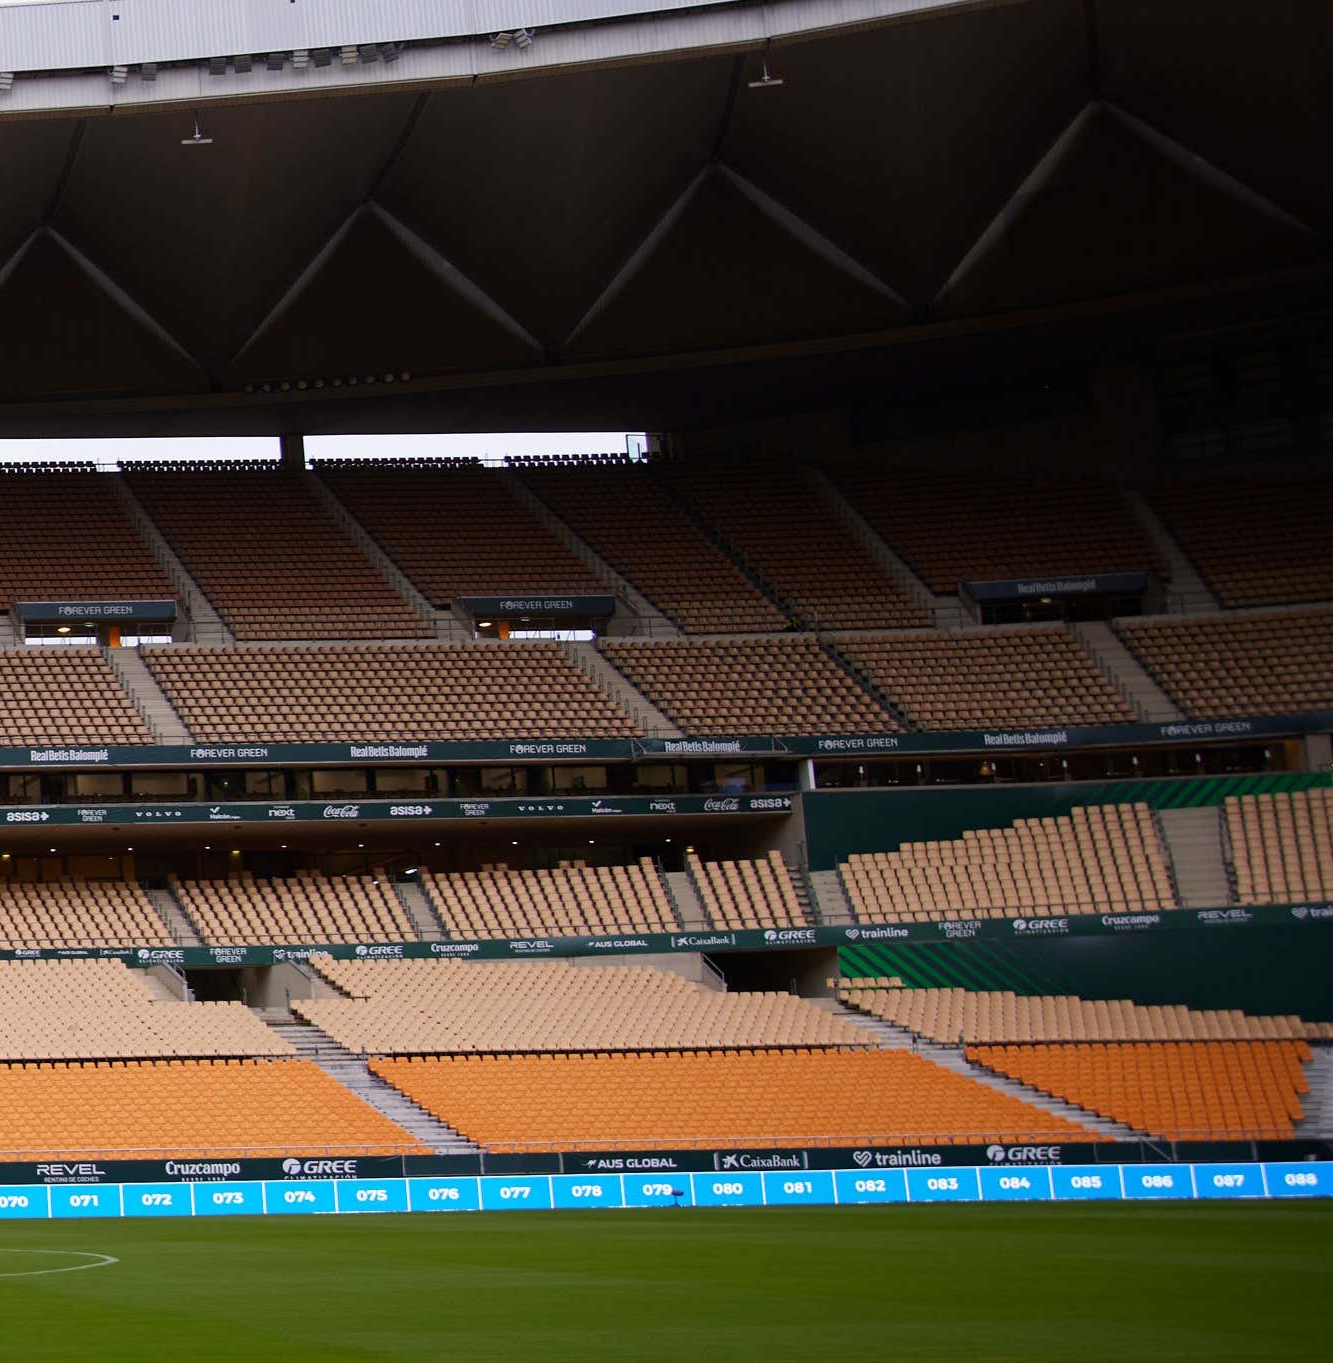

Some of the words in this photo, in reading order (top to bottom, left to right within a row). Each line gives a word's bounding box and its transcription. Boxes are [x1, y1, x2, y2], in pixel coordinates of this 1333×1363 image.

[58, 607, 102, 615] FOREVER
[103, 606, 134, 614] GREEN
[499, 601, 542, 609] FOREVER
[31, 751, 48, 761] Real
[49, 751, 69, 760] Betis
[70, 750, 108, 760] Balompié
[351, 747, 368, 757] Real
[369, 747, 388, 756] Betis
[389, 746, 427, 756] Balompié
[6, 812, 42, 821] asisa
[860, 928, 909, 938] trainline
[209, 948, 247, 956] FOREVER
[368, 946, 404, 954] GREE
[430, 944, 480, 952] Cruzcampo
[874, 1150, 942, 1165] trainline
[1007, 1147, 1061, 1160] GREE
[303, 1160, 358, 1173] GREE
[597, 1159, 624, 1168] AUS
[625, 1159, 678, 1167] GLOBAL
[737, 1155, 801, 1167] CaixaBank
[36, 1164, 106, 1175] REVEL
[165, 1163, 241, 1175] Cruzcampo
[855, 1180, 886, 1192] 082
[927, 1178, 959, 1190] 083
[999, 1177, 1031, 1188] 084
[1070, 1176, 1102, 1188] 085
[1141, 1176, 1174, 1187] 086
[1213, 1175, 1245, 1186] 087
[499, 1187, 531, 1198] 077
[571, 1186, 603, 1197] 078
[642, 1184, 674, 1195] 079
[712, 1183, 744, 1194] 080
[783, 1182, 813, 1193] 081
[212, 1192, 244, 1204] 073
[284, 1191, 316, 1202] 074
[356, 1190, 388, 1201] 075
[428, 1188, 460, 1199] 076
[69, 1195, 99, 1206] 071
[141, 1194, 173, 1205] 072
